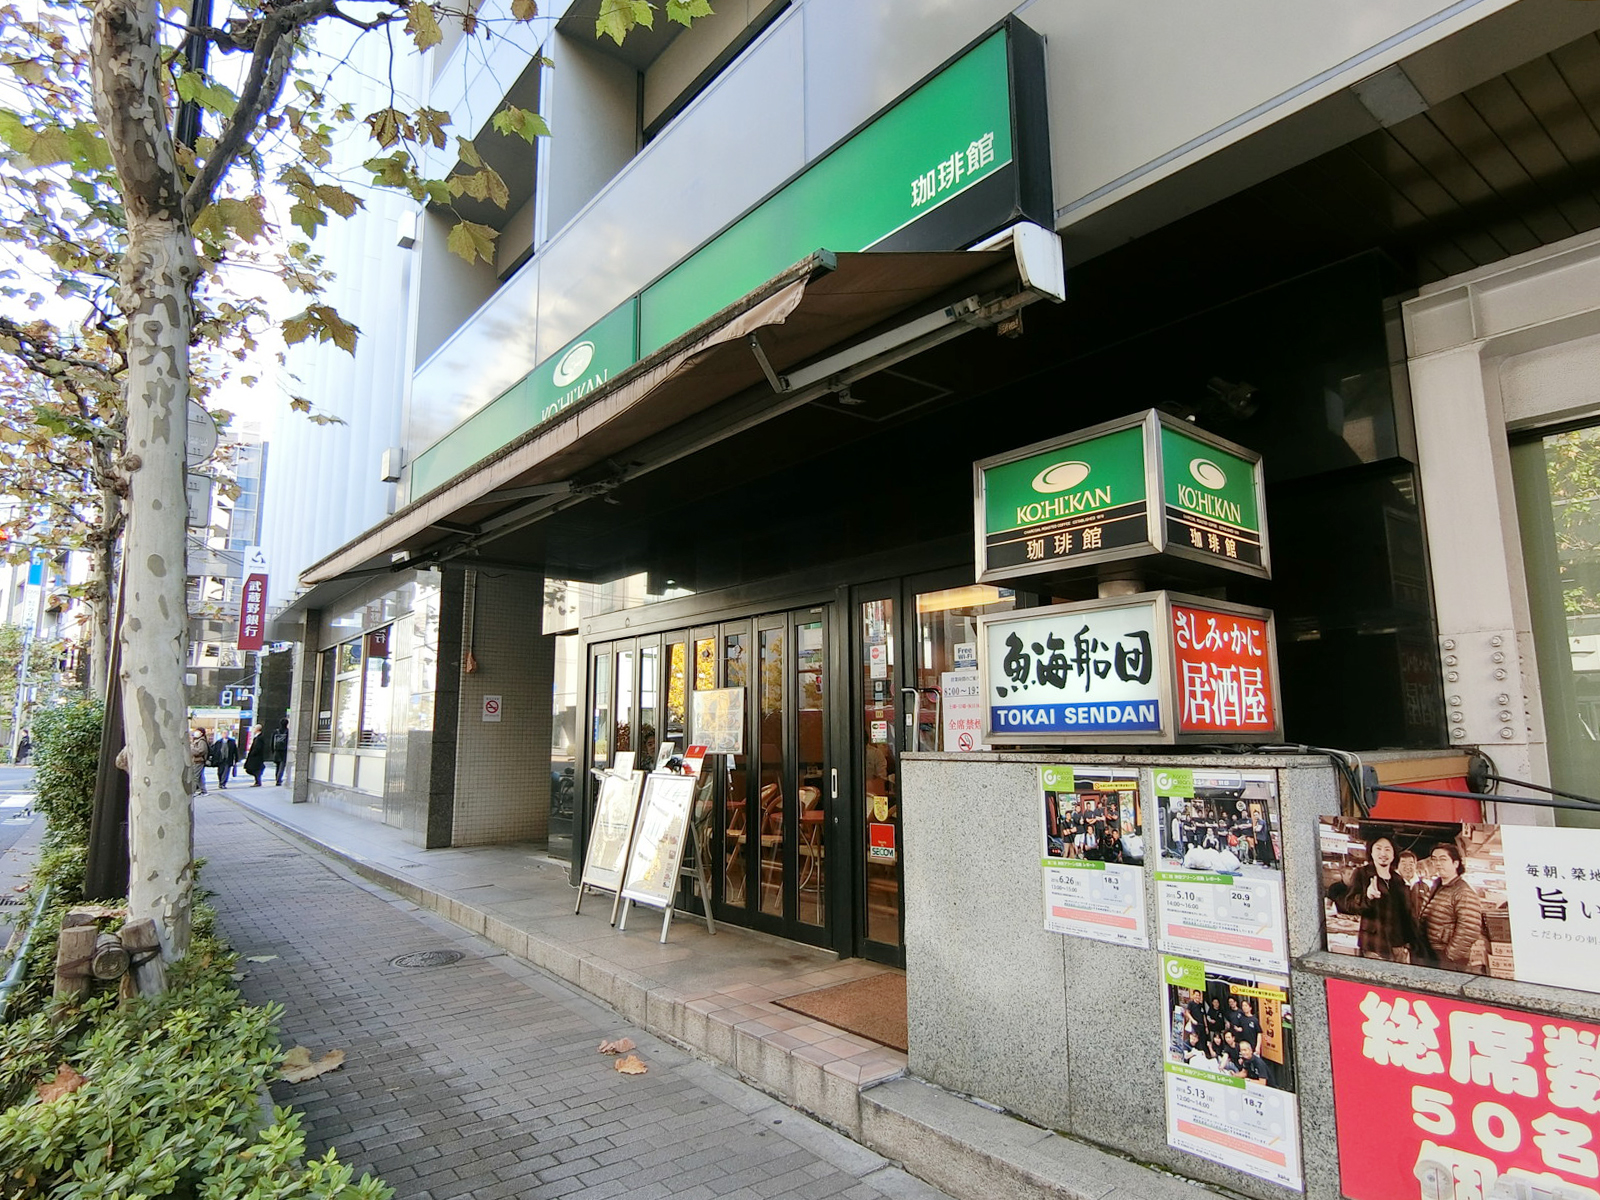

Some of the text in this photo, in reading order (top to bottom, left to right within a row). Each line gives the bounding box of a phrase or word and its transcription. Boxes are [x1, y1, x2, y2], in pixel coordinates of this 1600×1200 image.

[911, 131, 994, 208] 珈琲館
[1026, 527, 1102, 560] 珈琲館
[1189, 528, 1238, 559] 珈琲館
[244, 580, 262, 637] 武蔵野銀行
[1182, 659, 1268, 726] 居酒屋
[997, 704, 1155, 726] TOKAI SENDAN
[871, 847, 894, 857] SECOM
[1058, 875, 1075, 885] 6.26
[1176, 890, 1195, 901] 5.10
[1231, 892, 1250, 901] 20.9
[1186, 1085, 1206, 1099] 5.13
[1244, 1097, 1263, 1108] 18.7
